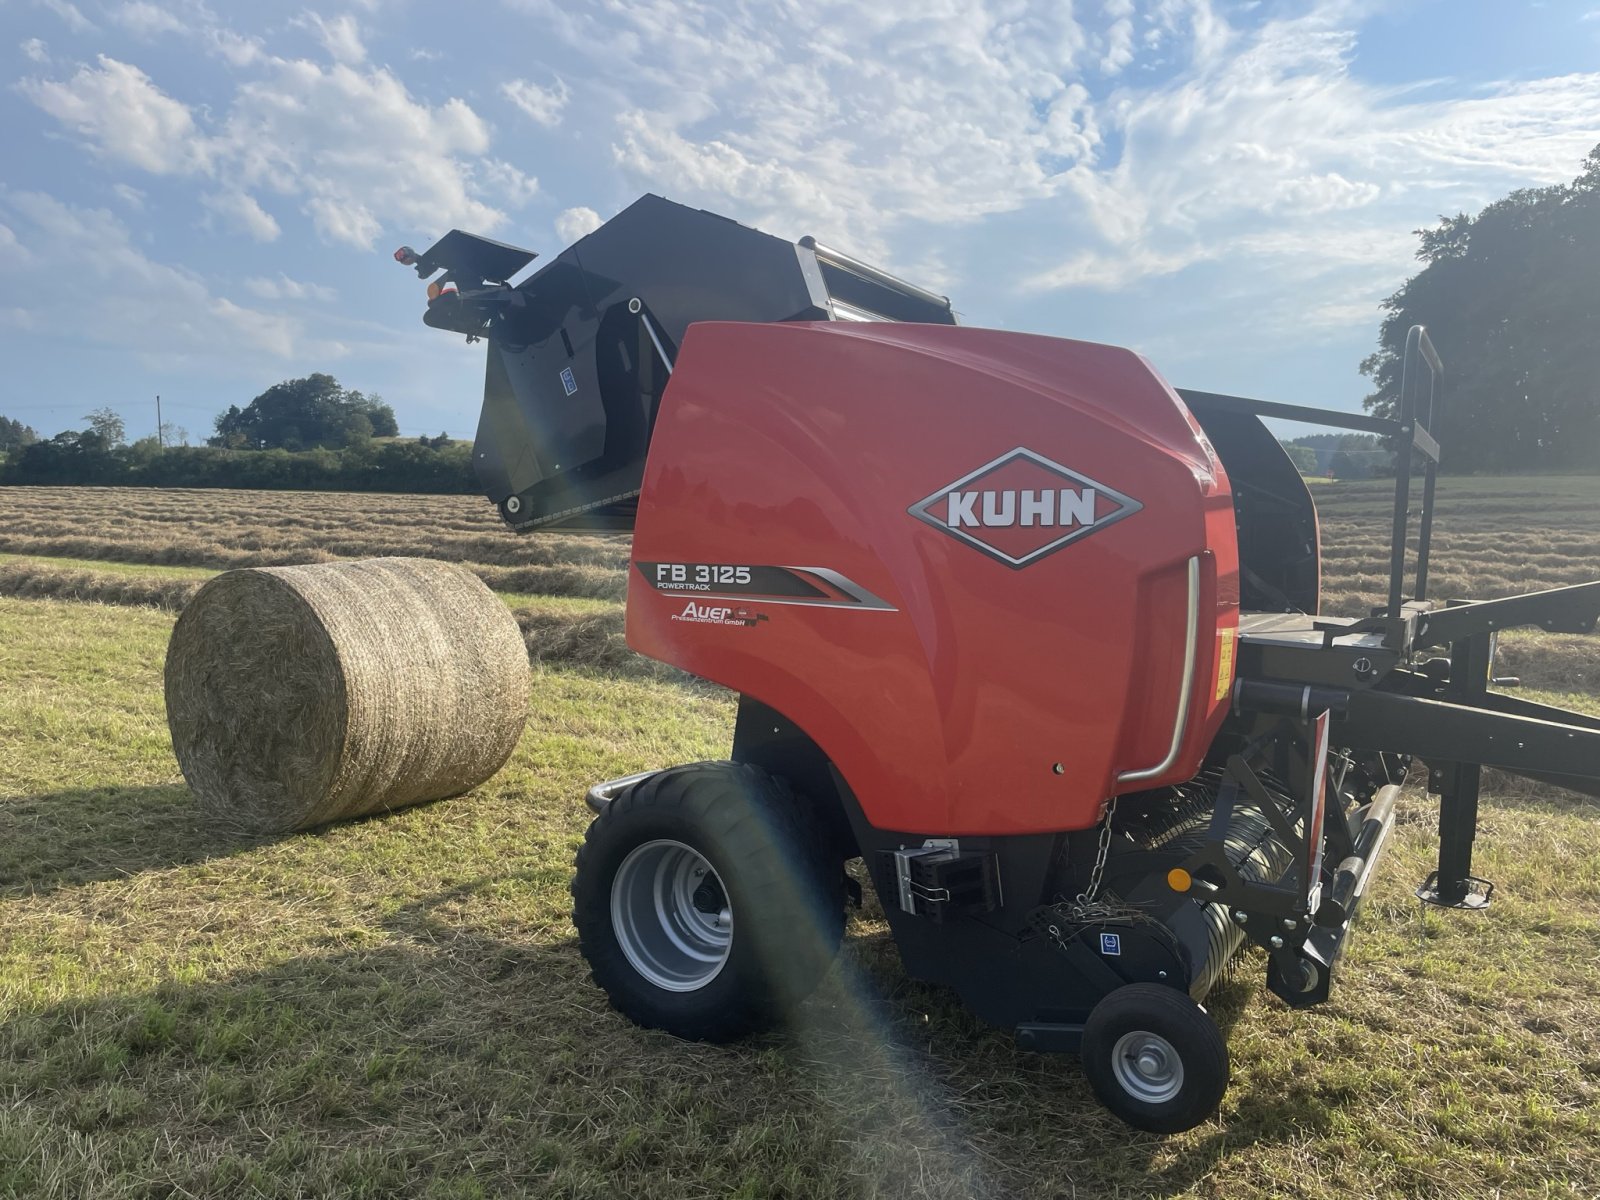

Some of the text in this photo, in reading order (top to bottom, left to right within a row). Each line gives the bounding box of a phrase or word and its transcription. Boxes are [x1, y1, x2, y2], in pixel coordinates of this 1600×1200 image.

[948, 489, 1095, 527] KUHN
[657, 564, 751, 584] FB 3125
[657, 582, 711, 591] POWERTRACK
[681, 601, 732, 620] Auer
[724, 618, 746, 626] GmbH
